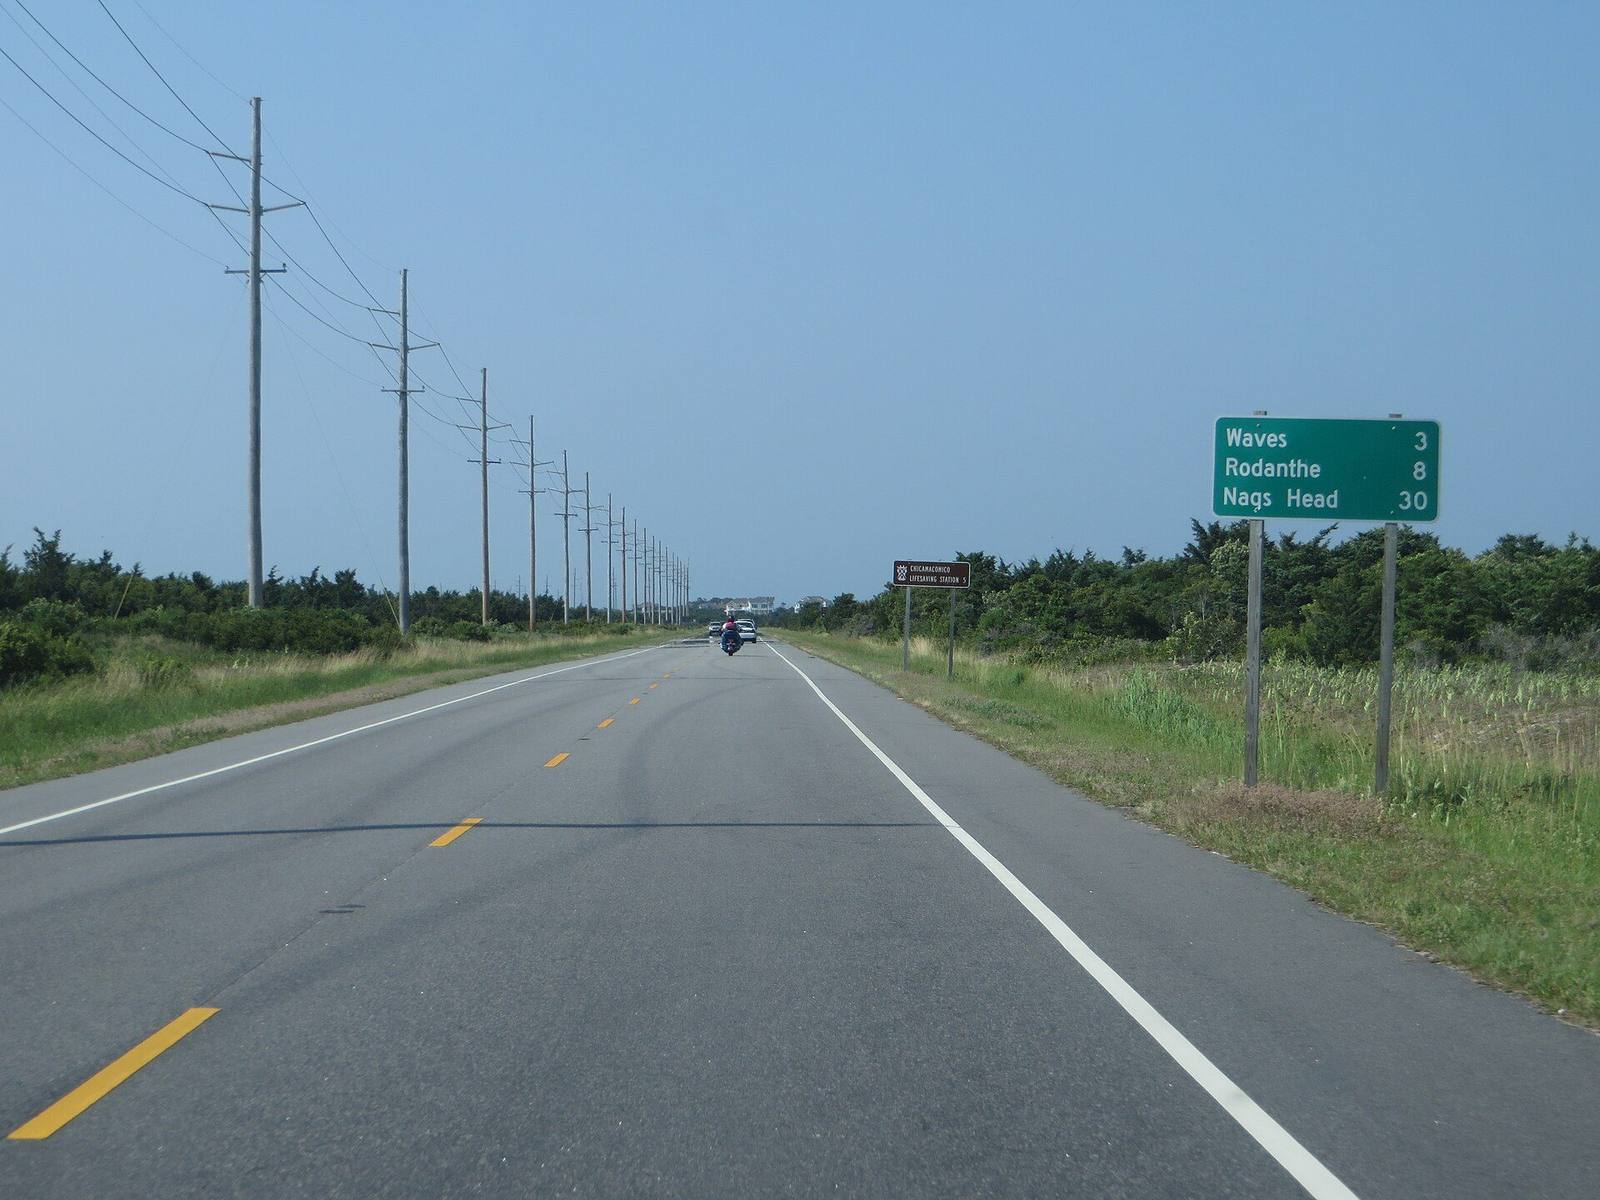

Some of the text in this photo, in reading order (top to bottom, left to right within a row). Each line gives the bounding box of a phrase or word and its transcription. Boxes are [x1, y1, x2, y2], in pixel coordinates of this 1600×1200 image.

[1226, 428, 1427, 451] Waves 3
[1225, 457, 1426, 480] Rodanthe 8
[1223, 487, 1427, 511] Nags Head 30
